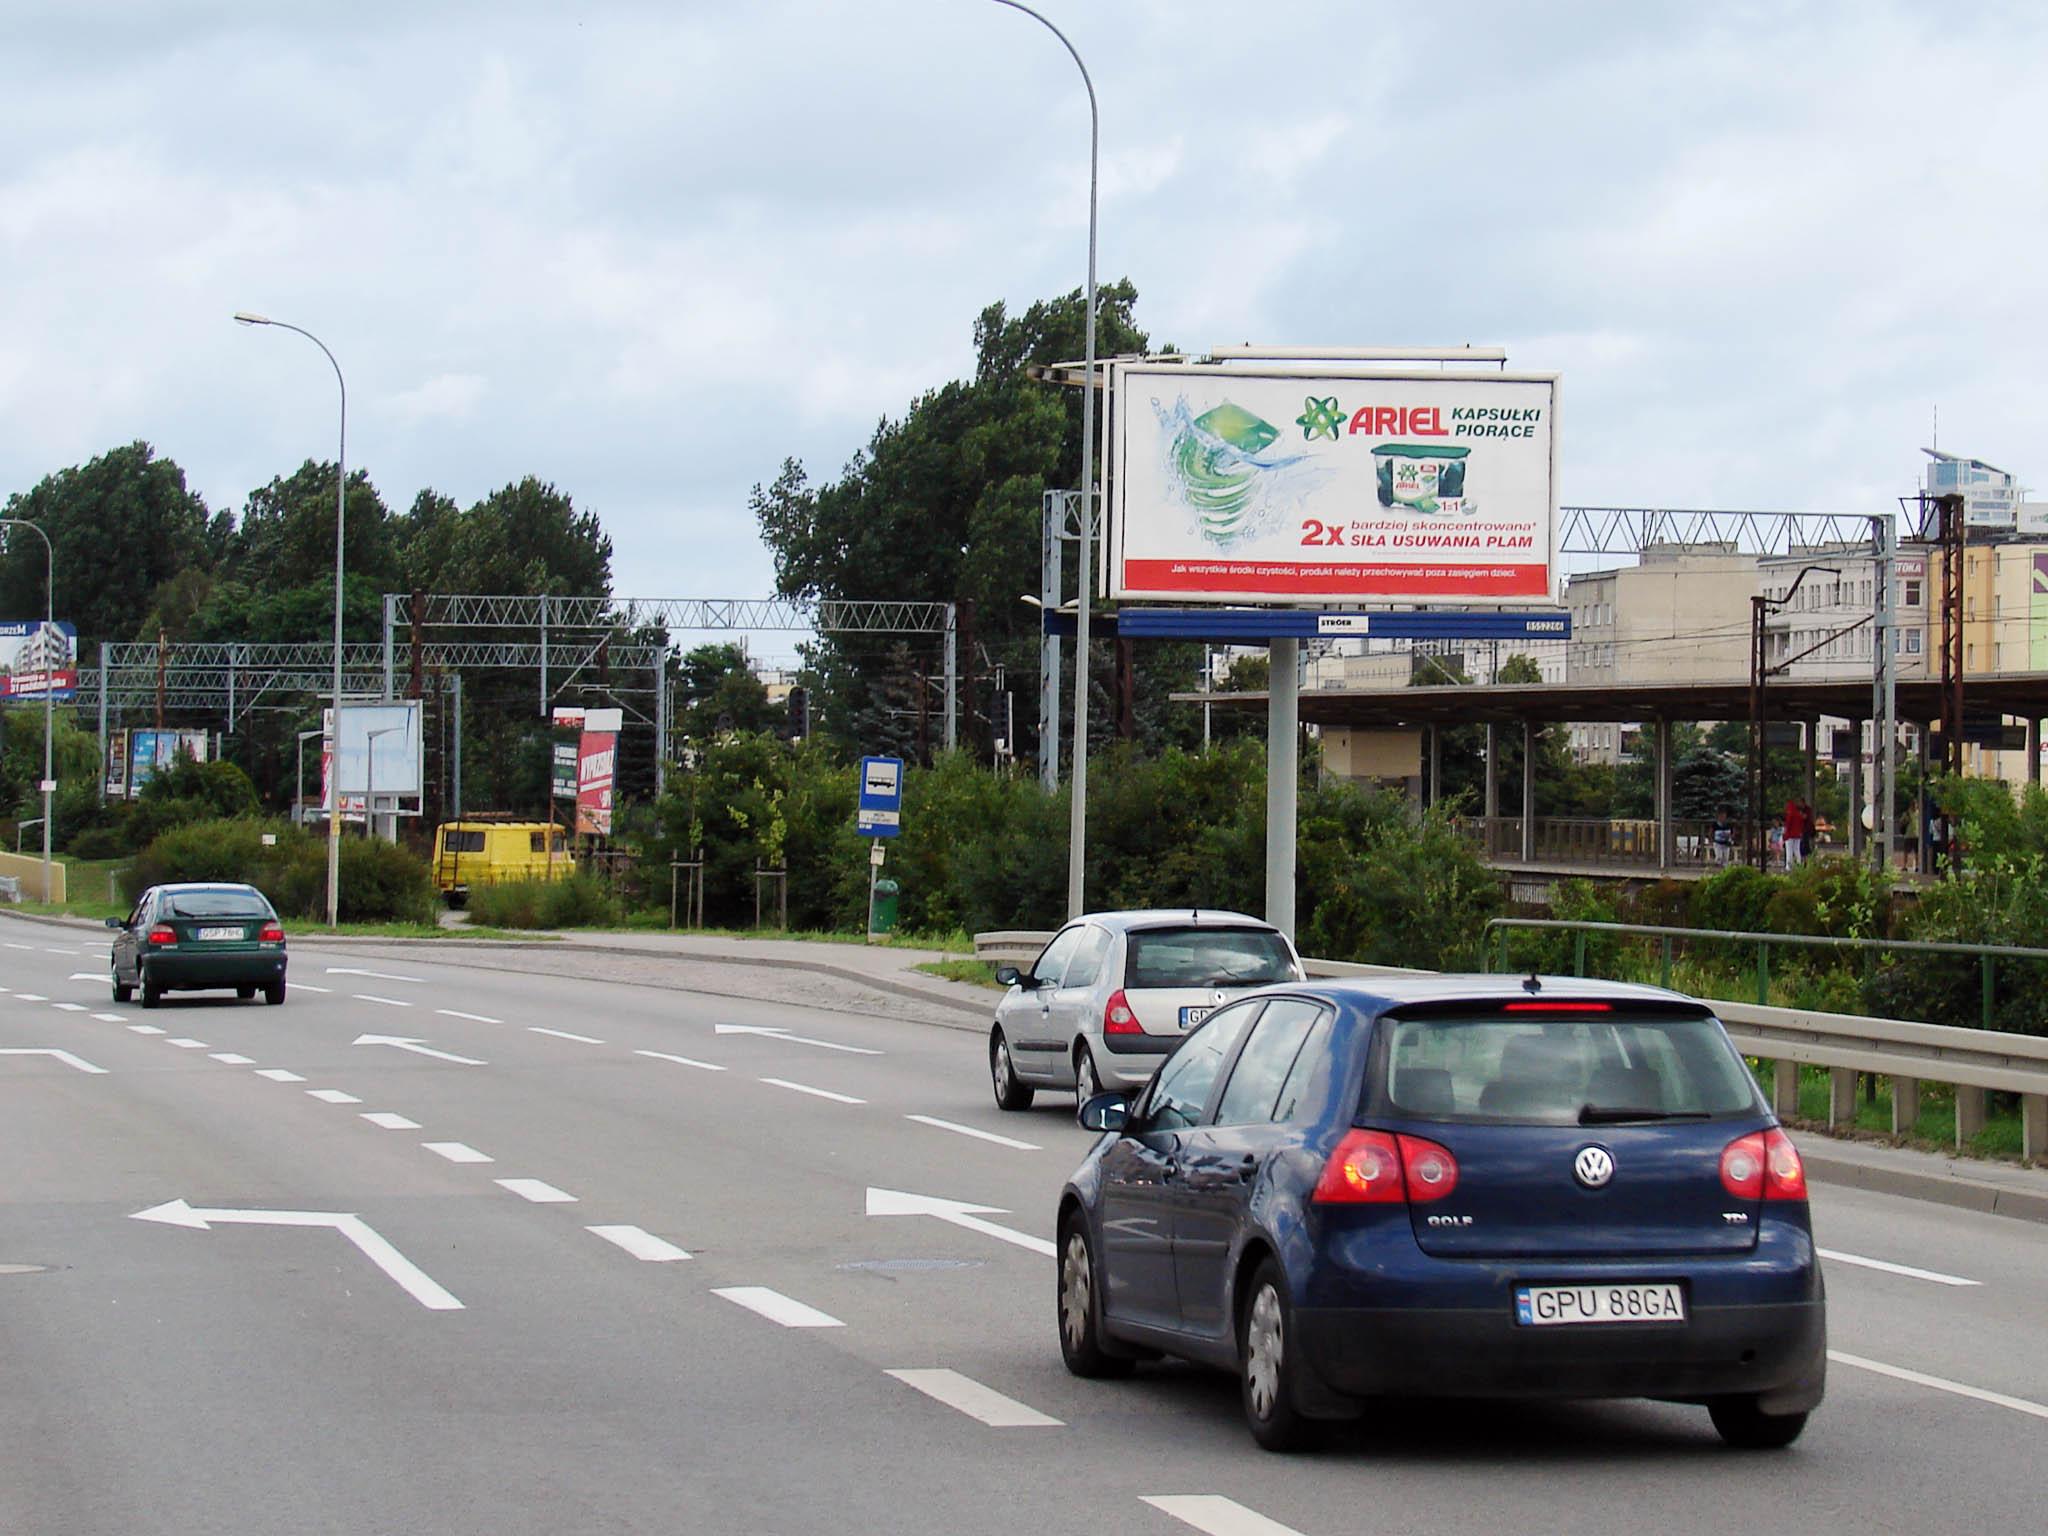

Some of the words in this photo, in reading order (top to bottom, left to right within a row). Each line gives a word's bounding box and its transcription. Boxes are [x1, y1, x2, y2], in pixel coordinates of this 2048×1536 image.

[1348, 406, 1449, 436] ARIEL
[1451, 407, 1541, 421] KAPSUŁKI
[1455, 424, 1535, 441] PIORĄCE
[1300, 519, 1345, 546] 2x
[1351, 520, 1408, 532] bardziej
[1350, 534, 1387, 547] SIŁA
[1392, 535, 1481, 548] USUWANIA
[1486, 536, 1534, 548] PLAM
[1171, 564, 1187, 573] Jak
[1188, 564, 1227, 575] wszystkie
[1229, 565, 1255, 575] środki
[1300, 566, 1333, 577] produkt
[1335, 567, 1361, 577] należy
[1362, 568, 1424, 578] przechowywać
[1425, 569, 1446, 578] poza
[1447, 568, 1489, 579] zasięgiem
[1490, 568, 1517, 577] dzieci.
[1427, 1215, 1473, 1227] GOLF
[1536, 1290, 1597, 1319] GPU
[1609, 1288, 1679, 1316] 88GA
